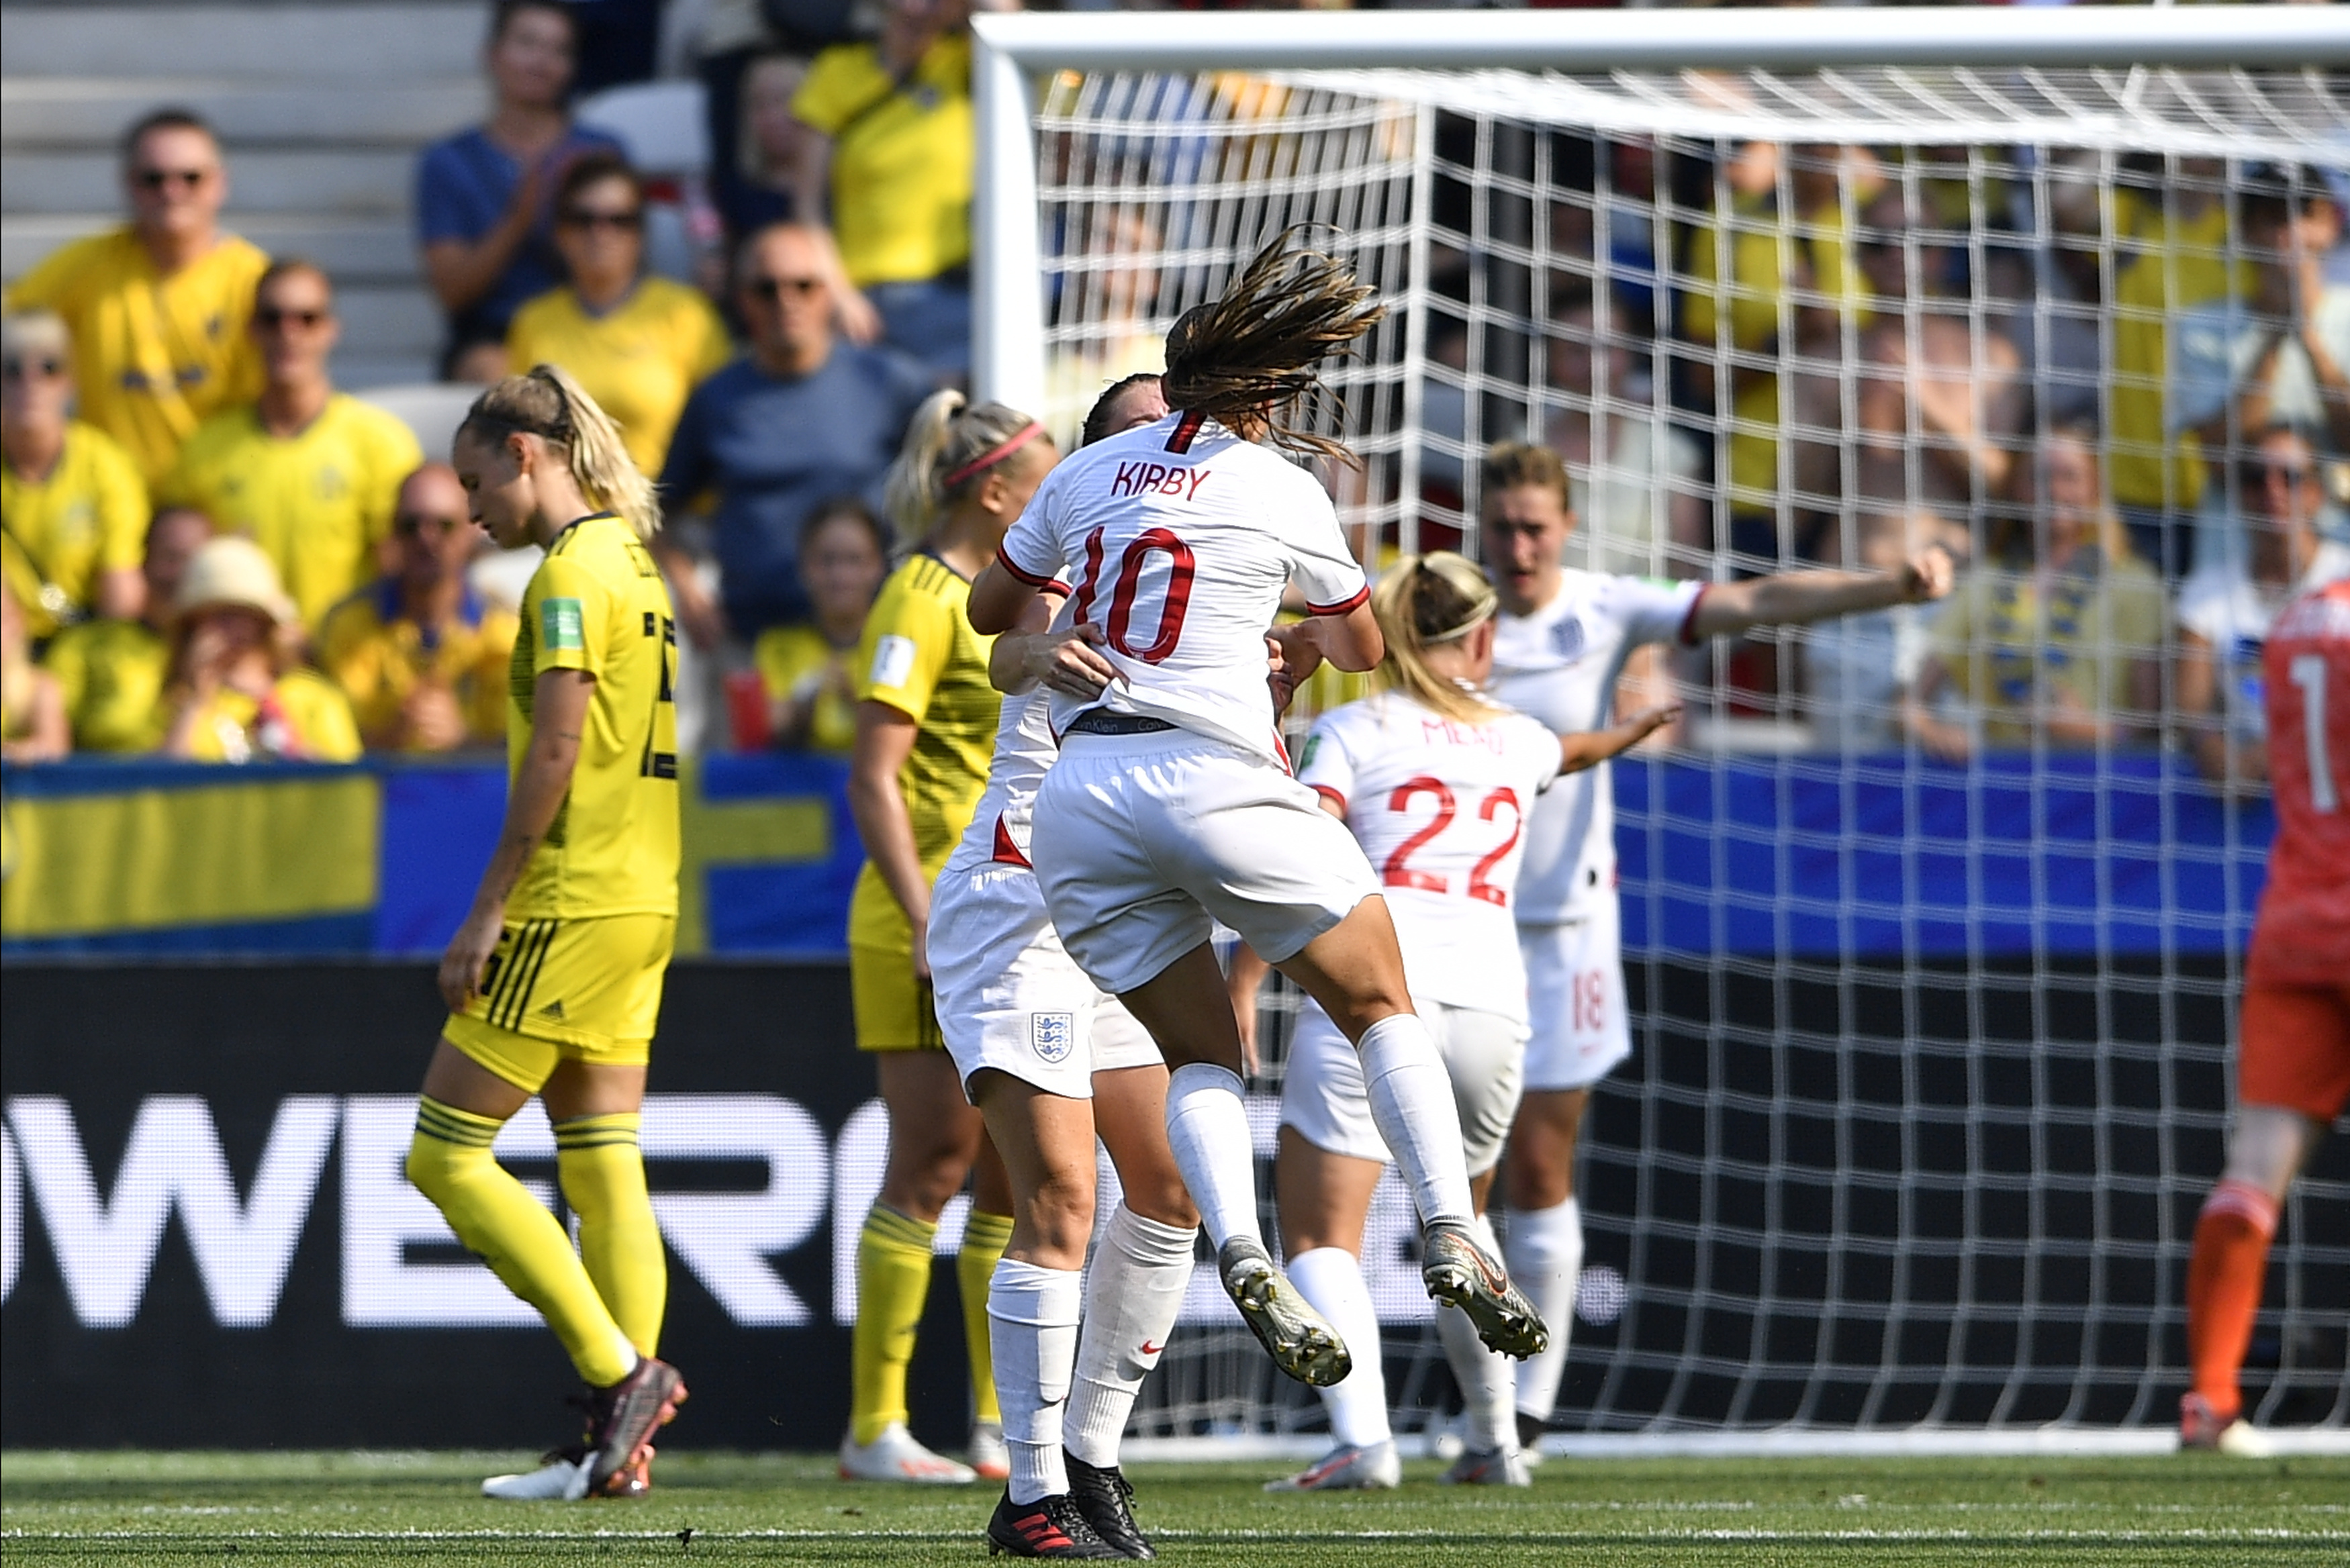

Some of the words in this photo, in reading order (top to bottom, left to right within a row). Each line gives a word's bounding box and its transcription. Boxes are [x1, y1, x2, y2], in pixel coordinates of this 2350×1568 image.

[1110, 461, 1211, 501] KIRBY
[1074, 526, 1195, 665] 10
[2289, 654, 2335, 814] 1
[1384, 777, 1521, 908] 22
[1573, 971, 1605, 1032] 18
